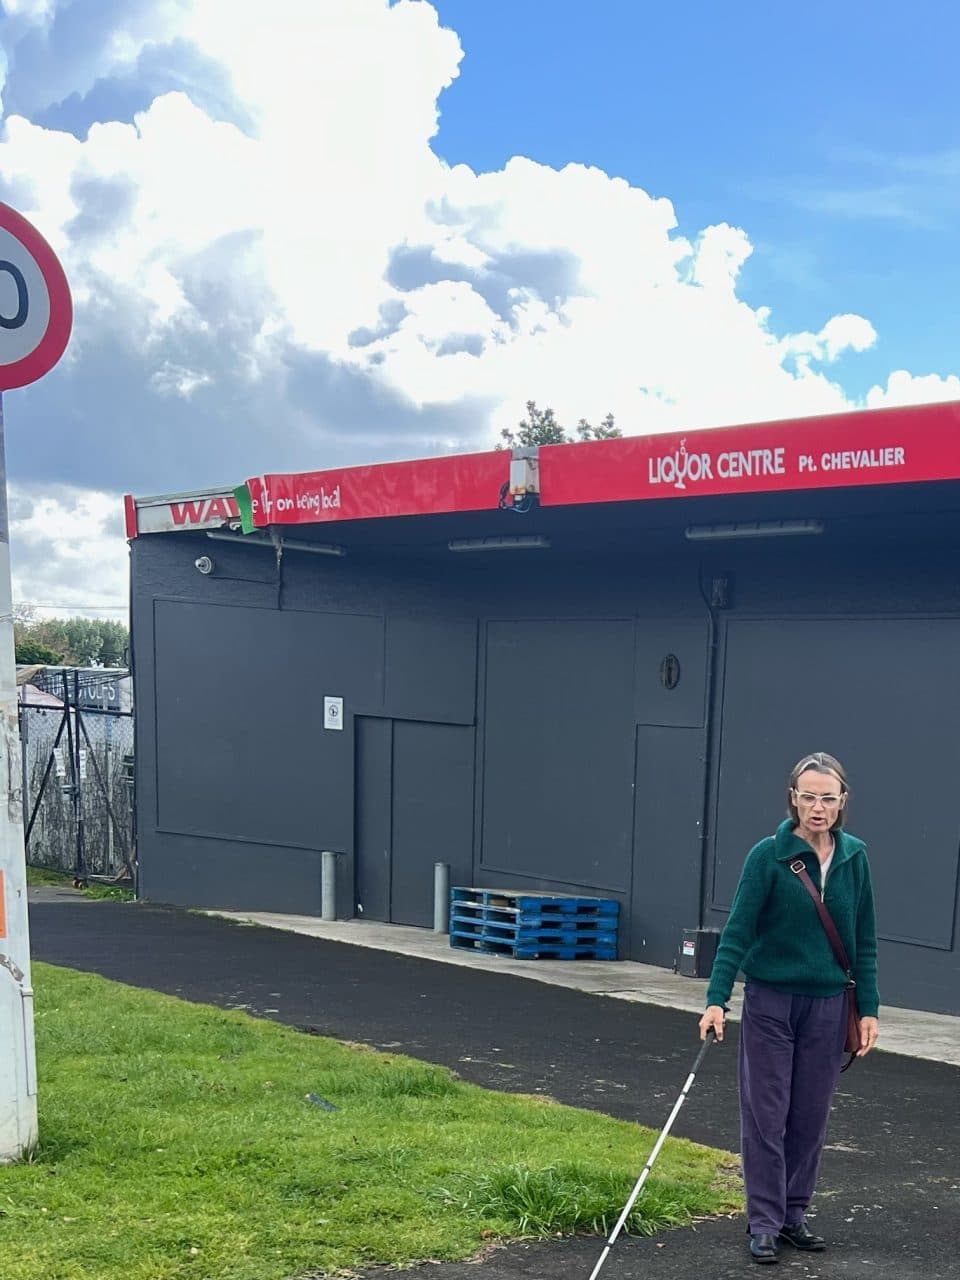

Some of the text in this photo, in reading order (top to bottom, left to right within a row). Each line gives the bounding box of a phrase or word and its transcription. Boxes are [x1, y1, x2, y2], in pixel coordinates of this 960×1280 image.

[648, 447, 905, 489] LIQUOR CENTRE Pt. CHEVALIER
